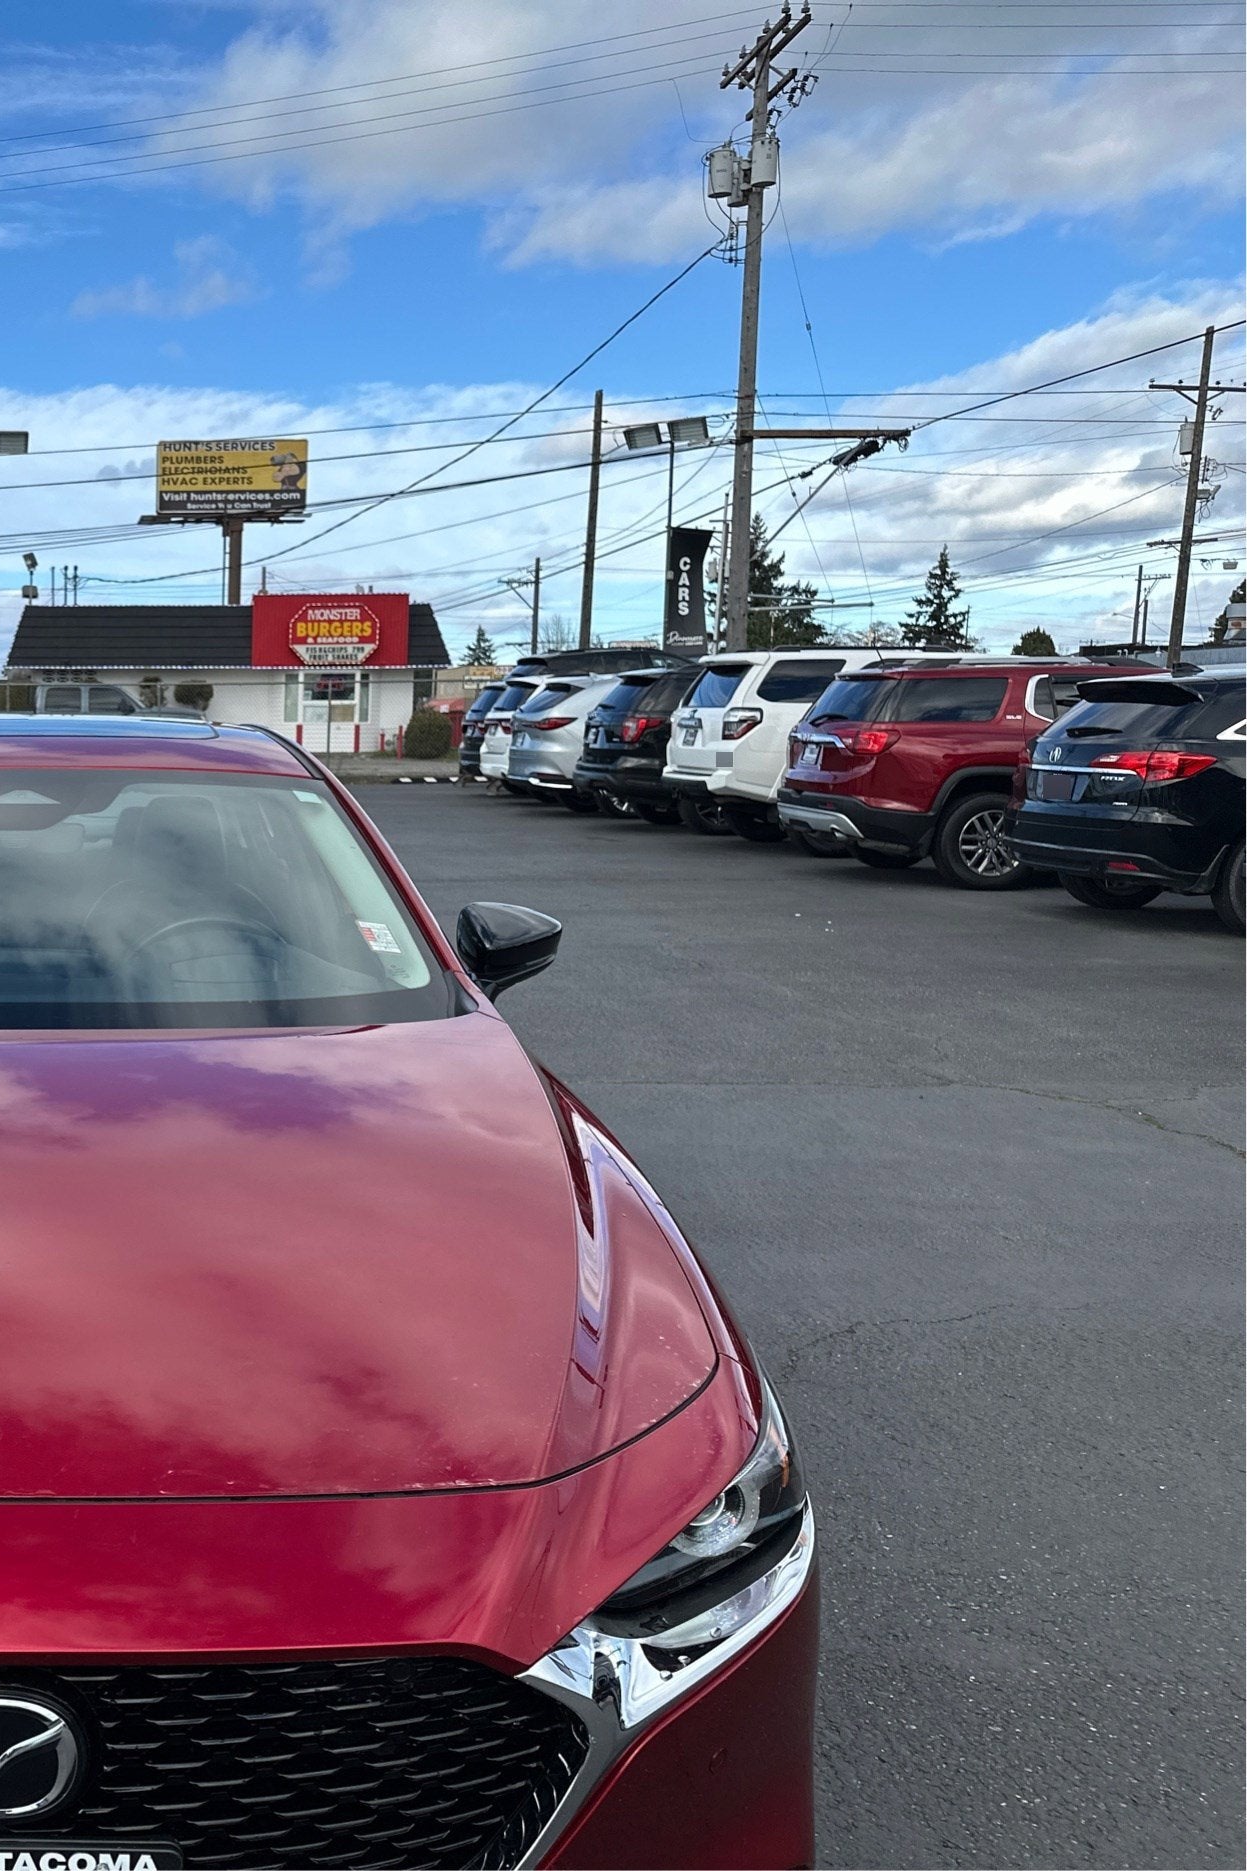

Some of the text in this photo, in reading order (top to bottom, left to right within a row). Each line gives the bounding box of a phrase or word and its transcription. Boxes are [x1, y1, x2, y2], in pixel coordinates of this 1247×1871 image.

[163, 441, 276, 452] HUNT'S SERVICES
[162, 455, 225, 465] PLUMBERS
[162, 466, 248, 475] ELECTRICIANS
[162, 476, 254, 486] HVAC EXPERTS
[162, 492, 188, 501] Visit
[678, 556, 691, 616] CARS
[307, 608, 361, 620] MONSTER
[296, 621, 372, 637] BURGERS
